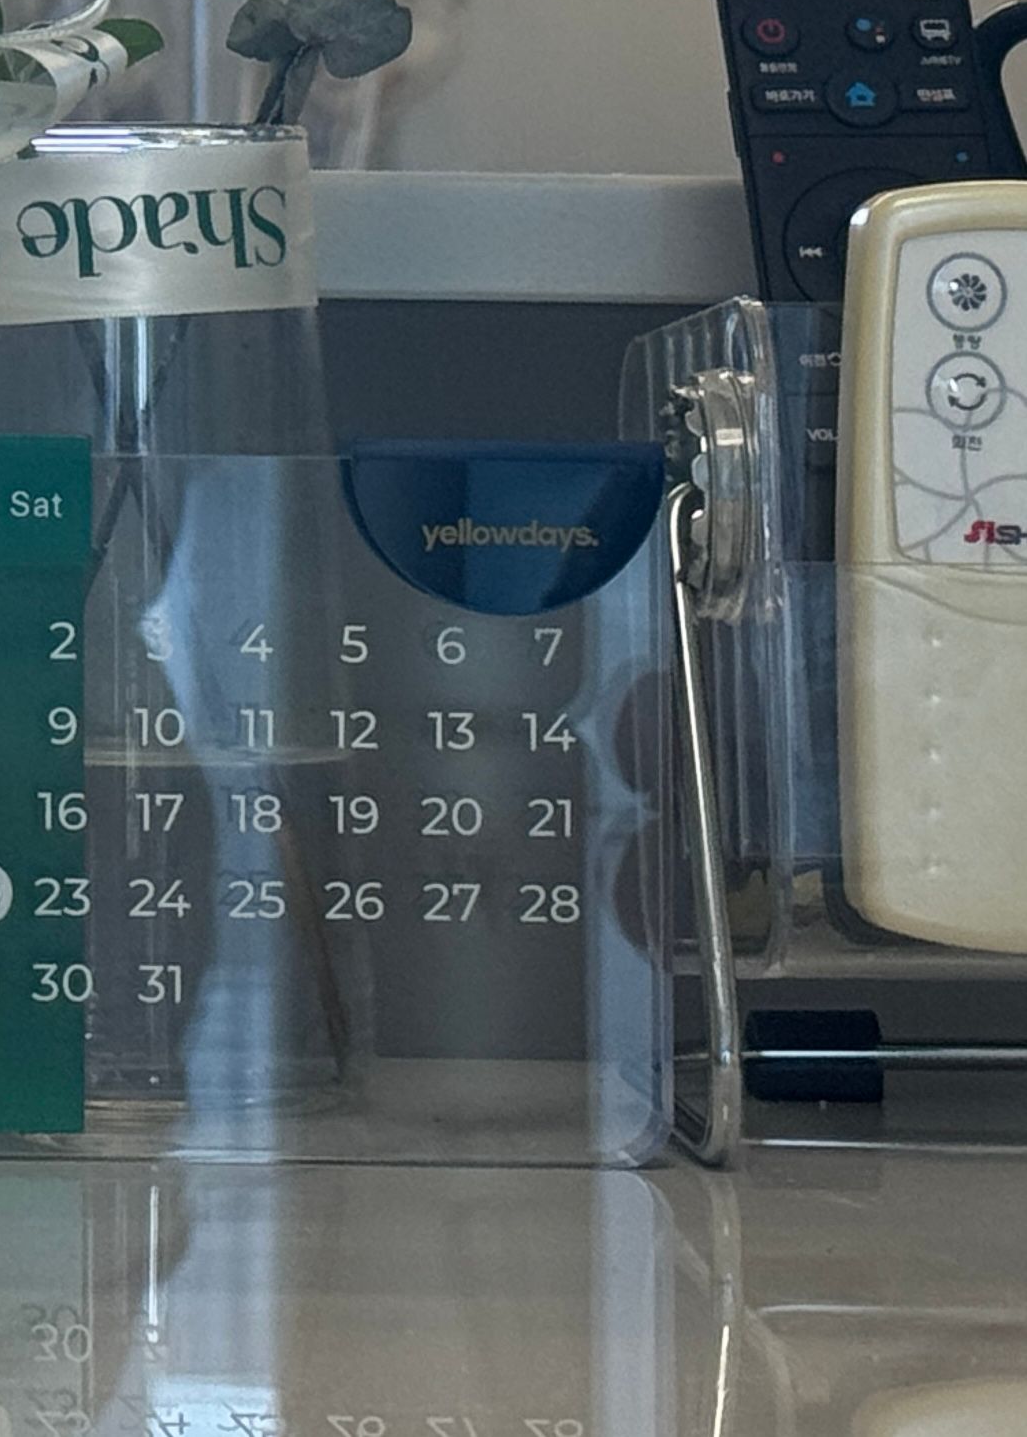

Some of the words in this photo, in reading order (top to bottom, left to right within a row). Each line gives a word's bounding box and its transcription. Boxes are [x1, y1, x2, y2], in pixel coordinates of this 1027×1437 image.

[17, 186, 286, 279] Shade
[10, 491, 61, 517] Sat
[422, 519, 600, 550] yellowdays.
[50, 622, 76, 659] 2
[241, 624, 273, 661] 4
[341, 626, 367, 662] 5
[437, 627, 465, 664] 6
[535, 628, 562, 666] 7
[49, 707, 77, 744] 9
[134, 708, 185, 746] 10
[240, 709, 273, 748] 11
[331, 711, 378, 748] 12
[428, 712, 474, 749] 13
[523, 713, 575, 751] 14
[38, 792, 87, 830] 16
[136, 794, 183, 831] 17
[232, 795, 281, 832] 18
[330, 796, 378, 833] 19
[422, 797, 482, 835] 20
[529, 799, 571, 837] 21
[35, 878, 90, 915] 23
[130, 879, 191, 917] 24
[229, 881, 285, 918] 25
[325, 882, 383, 919] 26
[424, 884, 480, 921] 27
[520, 885, 579, 922] 28
[32, 964, 92, 1001] 30
[139, 965, 181, 1003] 31
